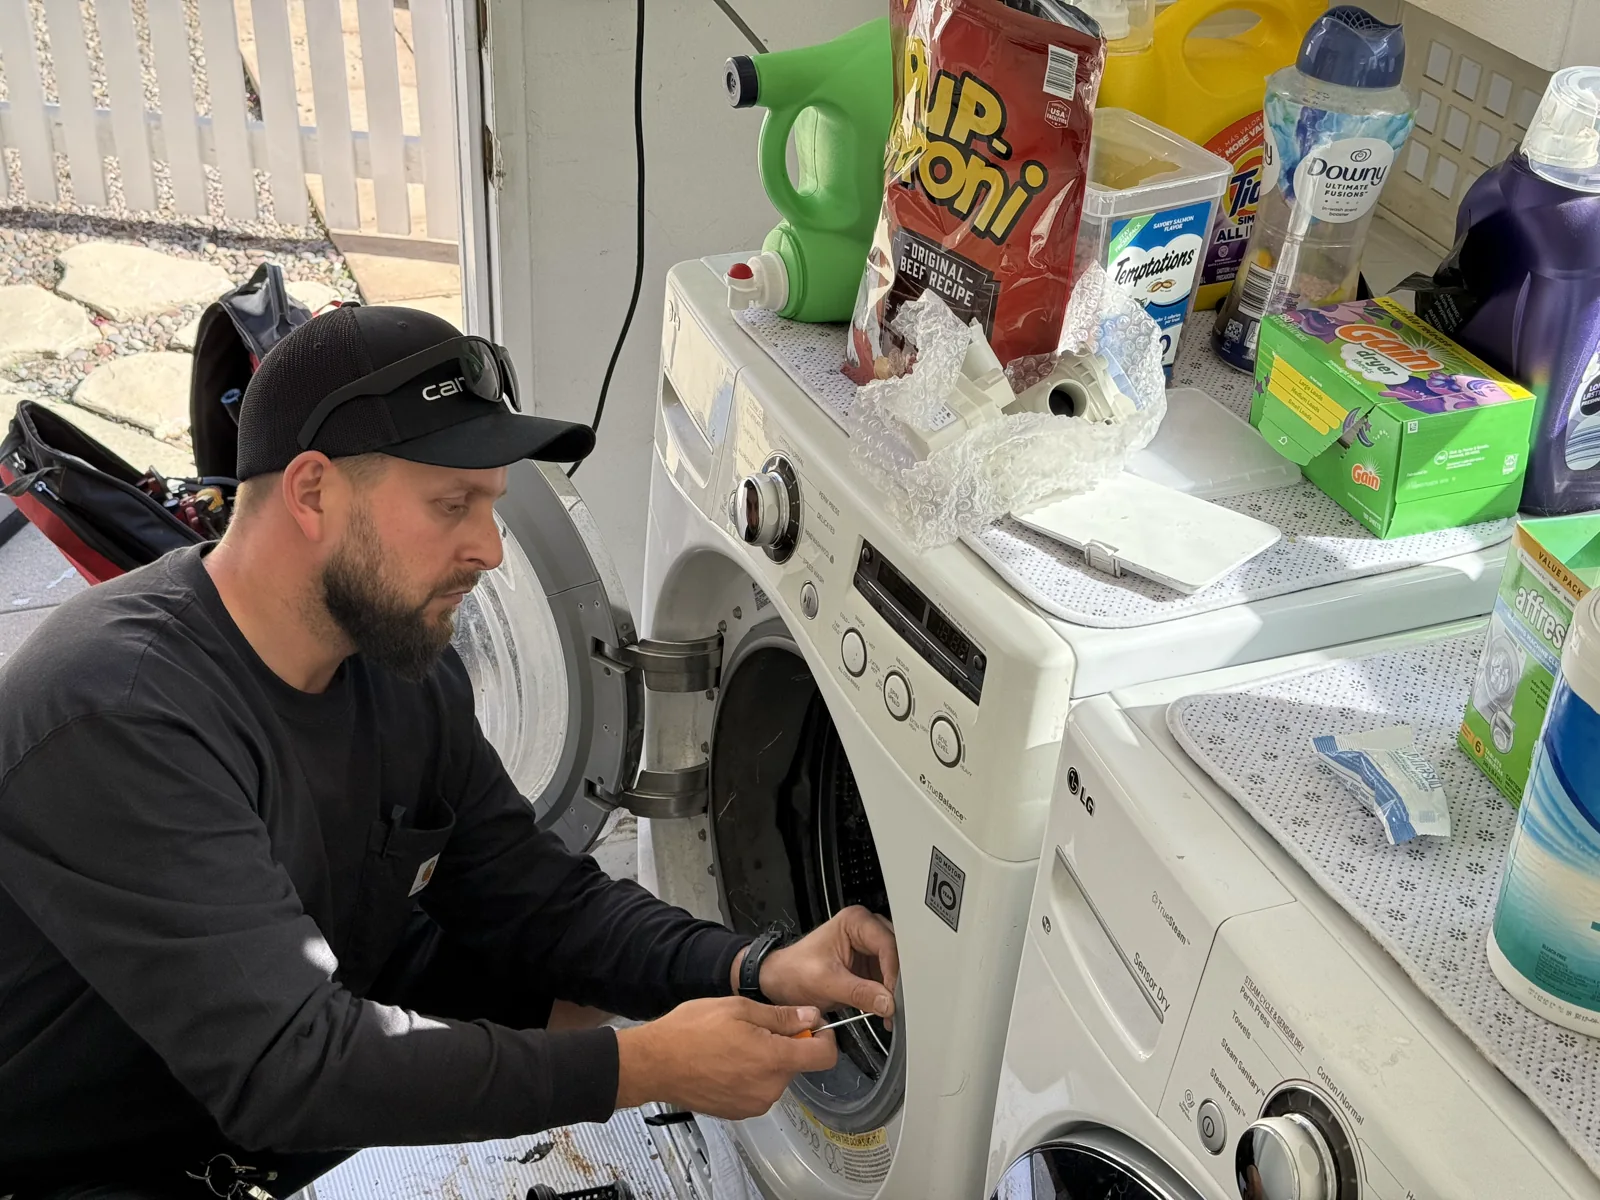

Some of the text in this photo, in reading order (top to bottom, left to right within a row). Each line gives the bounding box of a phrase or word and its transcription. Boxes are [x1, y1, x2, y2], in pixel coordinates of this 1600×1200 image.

[1050, 107, 1066, 118] USA
[1224, 134, 1250, 157] MORE
[1248, 122, 1264, 137] VAL
[1307, 157, 1388, 187] Downy
[1230, 167, 1262, 218] Ti
[1325, 182, 1369, 191] ULTIMATE
[1153, 215, 1195, 230] SAVORY SALMON
[1164, 223, 1183, 232] FLAVOR
[1237, 214, 1255, 226] SIM
[1216, 226, 1243, 242] ALL
[900, 256, 975, 308] BEEF RECIPE
[1114, 249, 1195, 288] Temptations
[1336, 324, 1443, 371] Gain
[1351, 358, 1375, 374] sheets
[1356, 350, 1399, 376] dryer
[421, 377, 466, 401] car
[1290, 387, 1320, 414] Medium Loads
[1298, 378, 1312, 392] Large
[1310, 387, 1324, 402] Loads
[1583, 390, 1600, 401] LAST
[1287, 398, 1313, 422] Small Loads
[1352, 463, 1380, 491] Gain
[1538, 551, 1562, 577] VALUE
[1562, 574, 1585, 598] PACK
[935, 738, 950, 755] LEVEL
[1474, 740, 1482, 754] 6
[1079, 785, 1096, 817] LG
[942, 860, 962, 881] MOTOR
[931, 871, 957, 911] 10
[942, 889, 953, 901] YEAR
[1133, 951, 1171, 1013] Sensor Dry
[1232, 1009, 1252, 1040] Towels
[1244, 975, 1262, 999] STEAM
[1260, 994, 1274, 1012] CYCLE
[1276, 1015, 1296, 1043] SENSOR
[1293, 1035, 1306, 1053] DRY
[1220, 1038, 1239, 1065] Steam
[1209, 1068, 1228, 1095] Steam
[1316, 1065, 1365, 1126] Cotton/Normal
